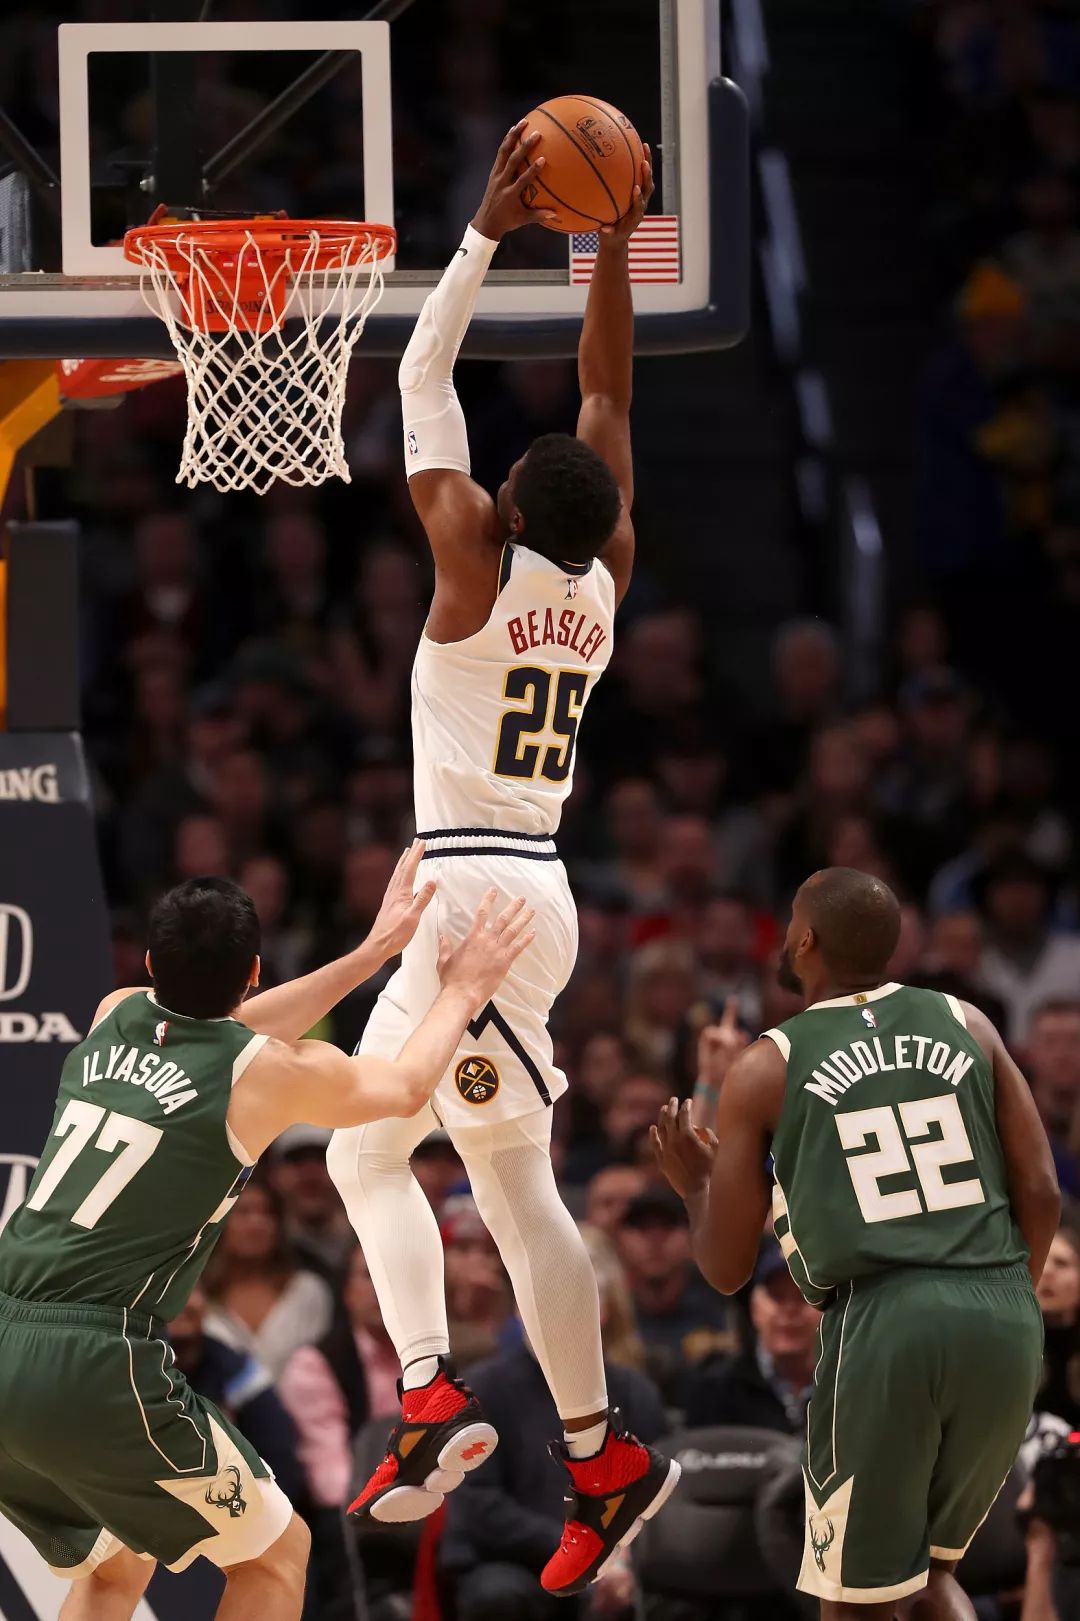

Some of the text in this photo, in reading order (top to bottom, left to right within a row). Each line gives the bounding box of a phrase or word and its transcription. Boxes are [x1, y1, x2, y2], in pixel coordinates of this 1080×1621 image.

[507, 608, 607, 663] BEASLEY
[493, 664, 590, 784] 25
[0, 1011, 83, 1042] DA
[82, 1044, 199, 1115] ILYASOVA
[803, 1034, 974, 1106] MIDDLETON
[26, 1099, 164, 1230] 77
[834, 1093, 986, 1223] 22
